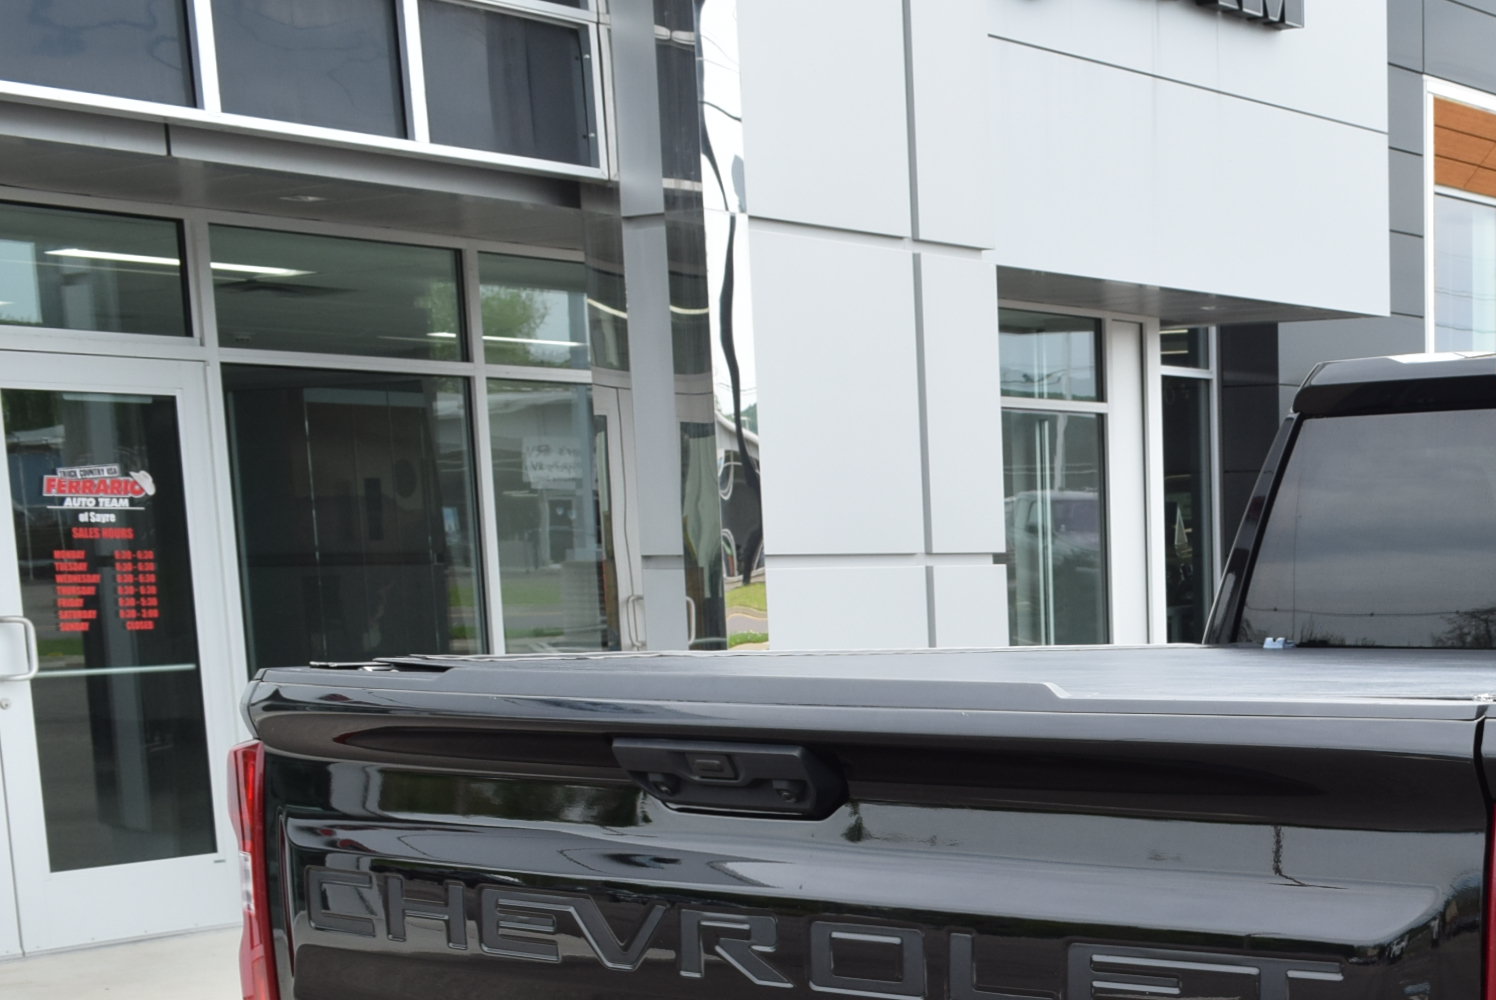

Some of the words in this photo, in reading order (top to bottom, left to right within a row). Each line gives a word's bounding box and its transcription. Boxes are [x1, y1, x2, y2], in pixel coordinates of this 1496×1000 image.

[79, 467, 105, 477] COUNTRY
[106, 466, 119, 475] USA
[44, 477, 145, 496] FERRARIO
[63, 497, 97, 507] AUTO
[98, 498, 130, 508] TEAM
[89, 512, 116, 523] Sayre
[72, 528, 100, 538] SALES
[101, 528, 134, 539] HOURS
